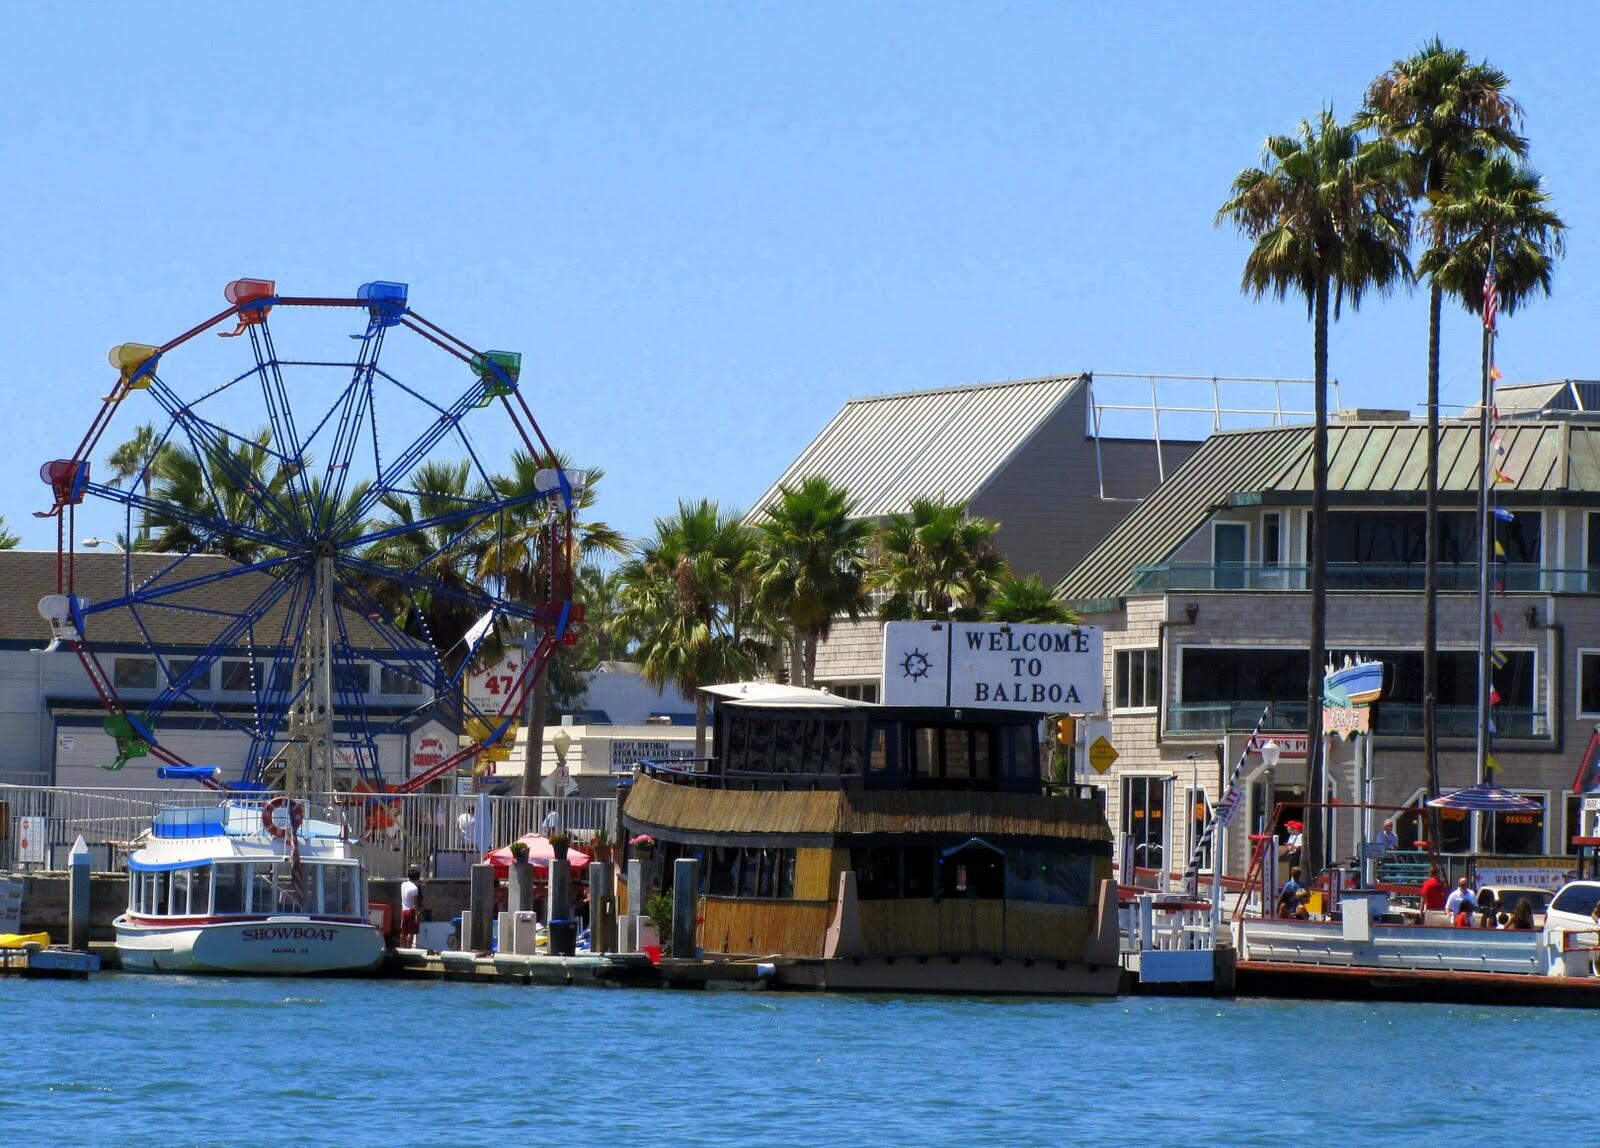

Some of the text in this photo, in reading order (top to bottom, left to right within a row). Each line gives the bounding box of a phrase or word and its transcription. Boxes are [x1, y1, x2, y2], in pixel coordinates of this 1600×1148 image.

[965, 632, 1090, 653] WELCOME
[1010, 658, 1042, 677] TO
[485, 675, 513, 695] 47
[974, 682, 1082, 703] BALBOA
[1505, 815, 1533, 824] PASTAS
[1495, 875, 1549, 884] WATER FUN!
[242, 928, 338, 941] SHOWBOAT
